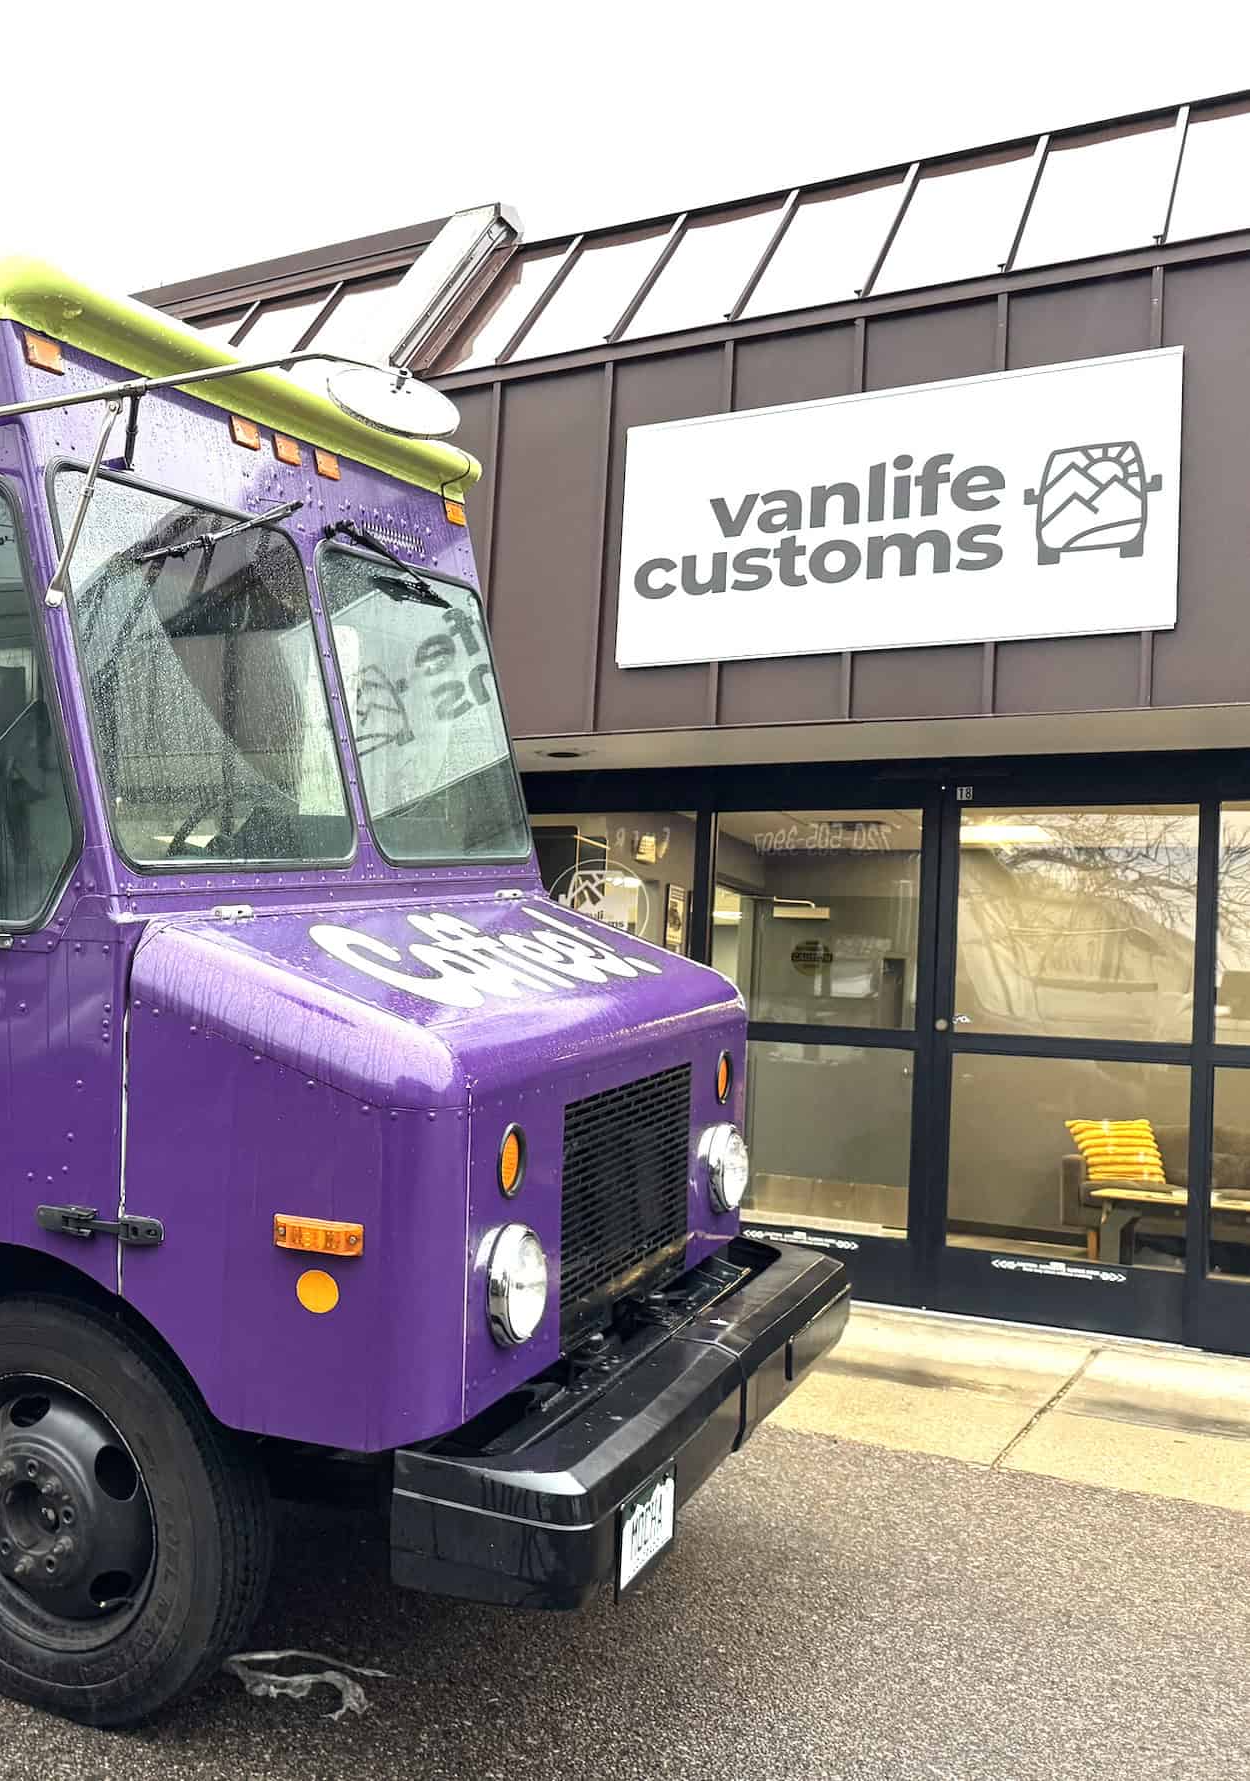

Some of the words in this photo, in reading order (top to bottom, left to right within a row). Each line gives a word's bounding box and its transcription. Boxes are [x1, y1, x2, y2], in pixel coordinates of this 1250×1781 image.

[709, 452, 1006, 538] vanlife
[634, 523, 1004, 600] customs
[308, 902, 663, 1009] Coffee!
